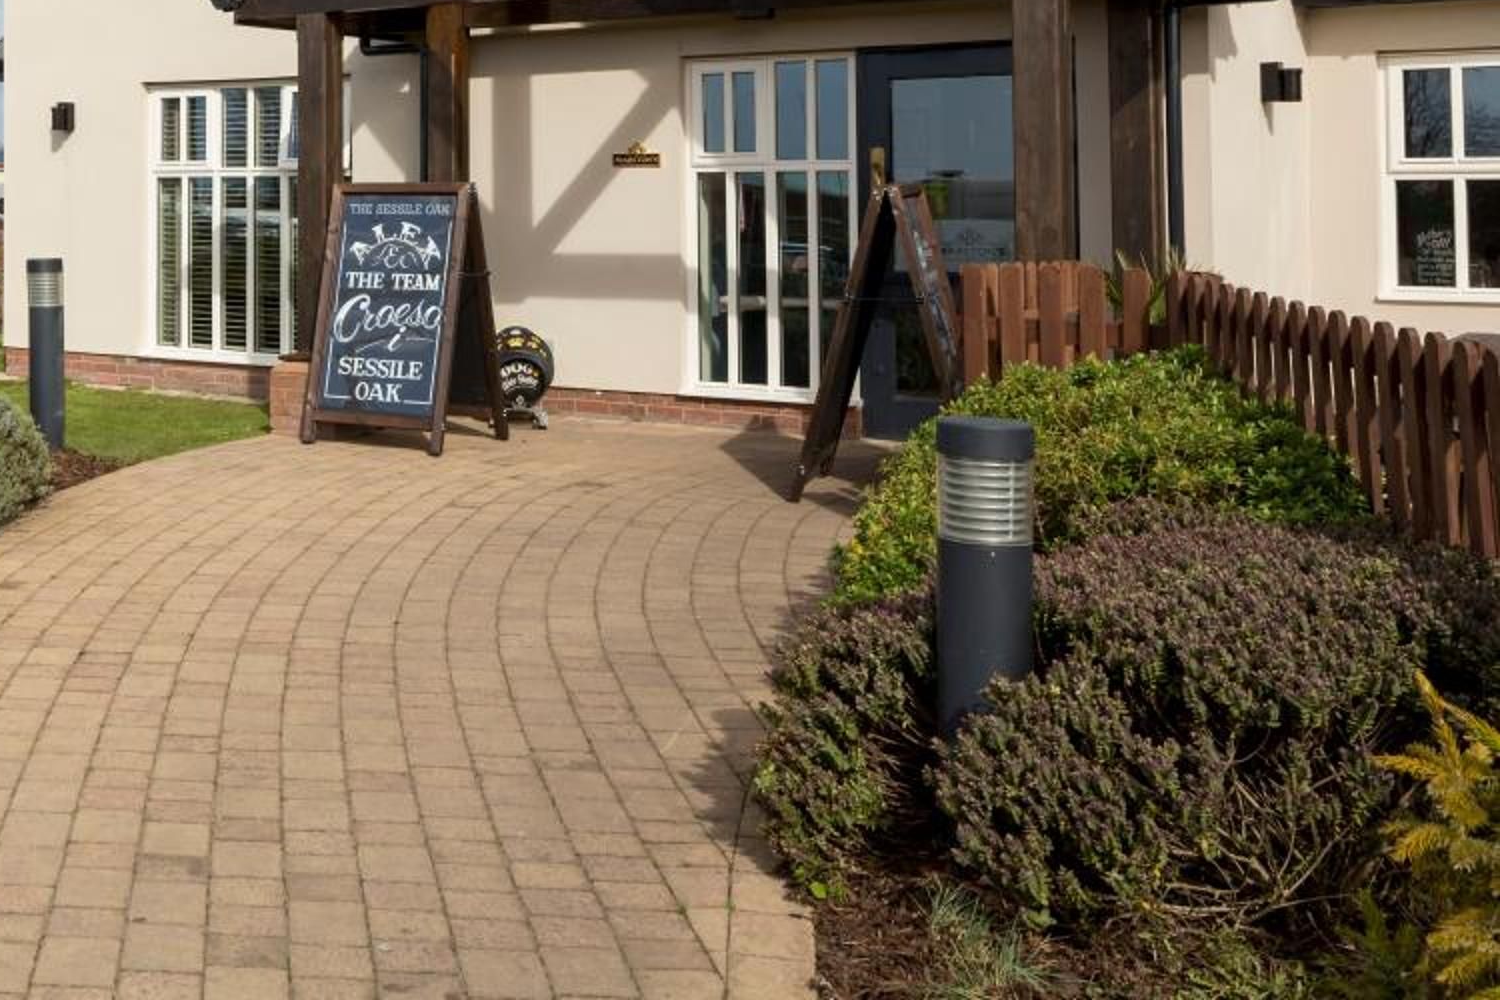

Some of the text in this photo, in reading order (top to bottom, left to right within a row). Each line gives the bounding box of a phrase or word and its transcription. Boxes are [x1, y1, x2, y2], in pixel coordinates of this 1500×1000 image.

[349, 203, 452, 217] THE SESSILE OAK
[346, 271, 441, 291] THE TEAM
[333, 294, 442, 343] Croeso
[338, 357, 423, 381] SESSILE
[355, 381, 403, 403] OAK
